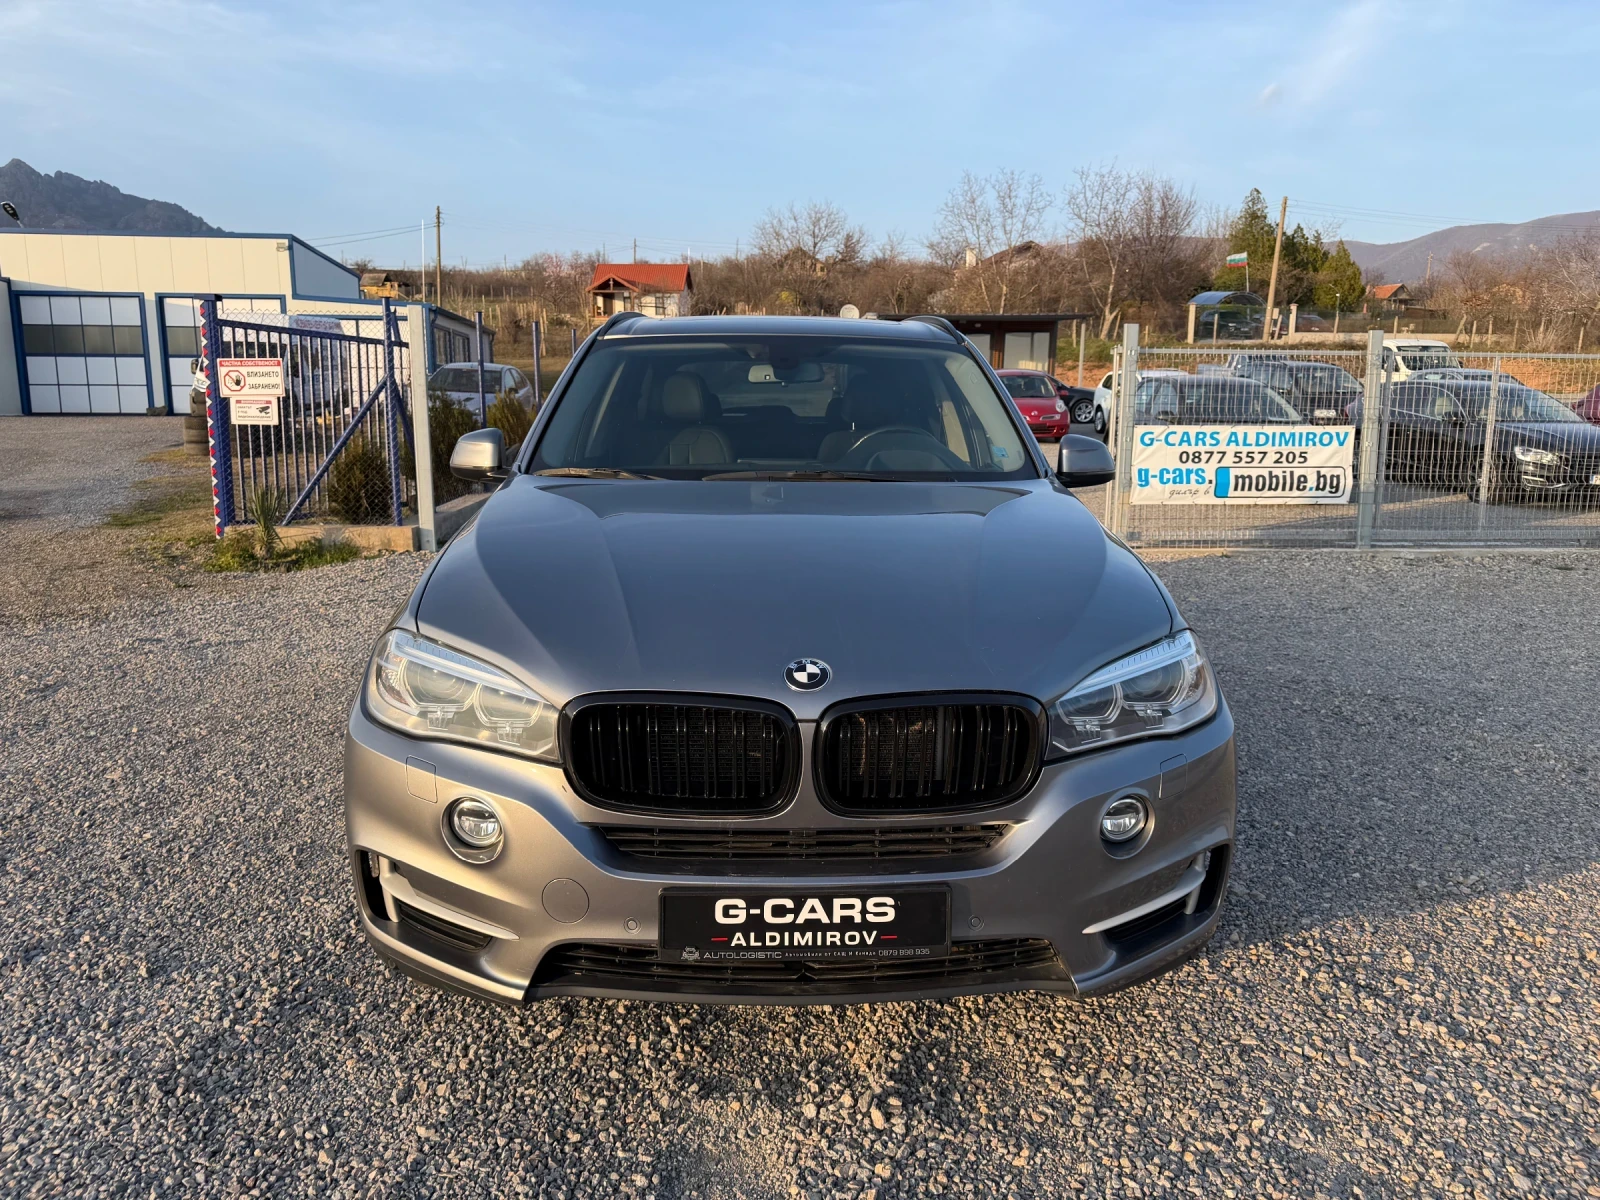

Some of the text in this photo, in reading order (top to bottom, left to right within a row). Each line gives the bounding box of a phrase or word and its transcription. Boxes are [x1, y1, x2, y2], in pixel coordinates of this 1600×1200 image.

[246, 370, 280, 378] ВЛИЗАНЕТО
[1139, 430, 1349, 447] G-CARS ALDIMIROV
[1179, 451, 1308, 464] 0877 557 205
[1233, 469, 1341, 494] mobile.bg
[714, 897, 896, 924] G-CARS
[730, 931, 877, 947] ALDIMIROV
[703, 951, 782, 959] AUTOLOGISTIC
[878, 949, 898, 957] 0879
